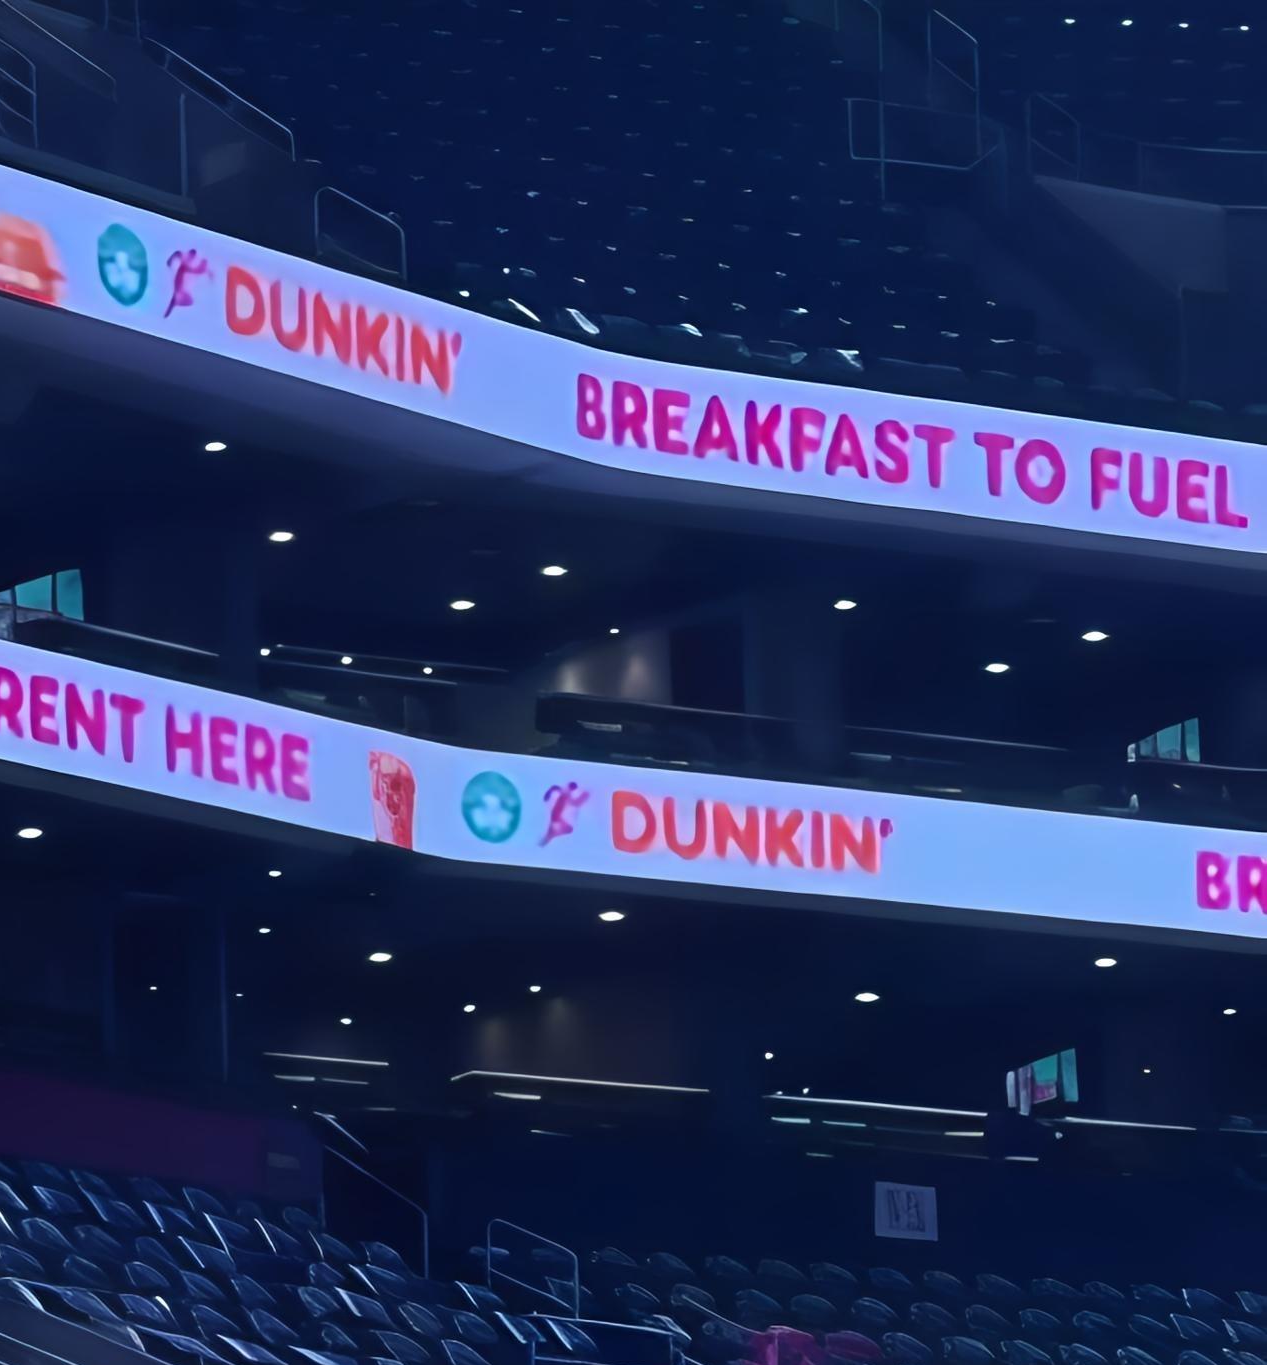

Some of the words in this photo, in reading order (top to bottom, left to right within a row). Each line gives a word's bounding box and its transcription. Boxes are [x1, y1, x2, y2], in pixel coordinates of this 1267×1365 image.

[577, 373, 955, 488] BREAKFAST
[974, 432, 1067, 505] TO
[1090, 447, 1250, 529] FUEL
[166, 707, 312, 801] HERE
